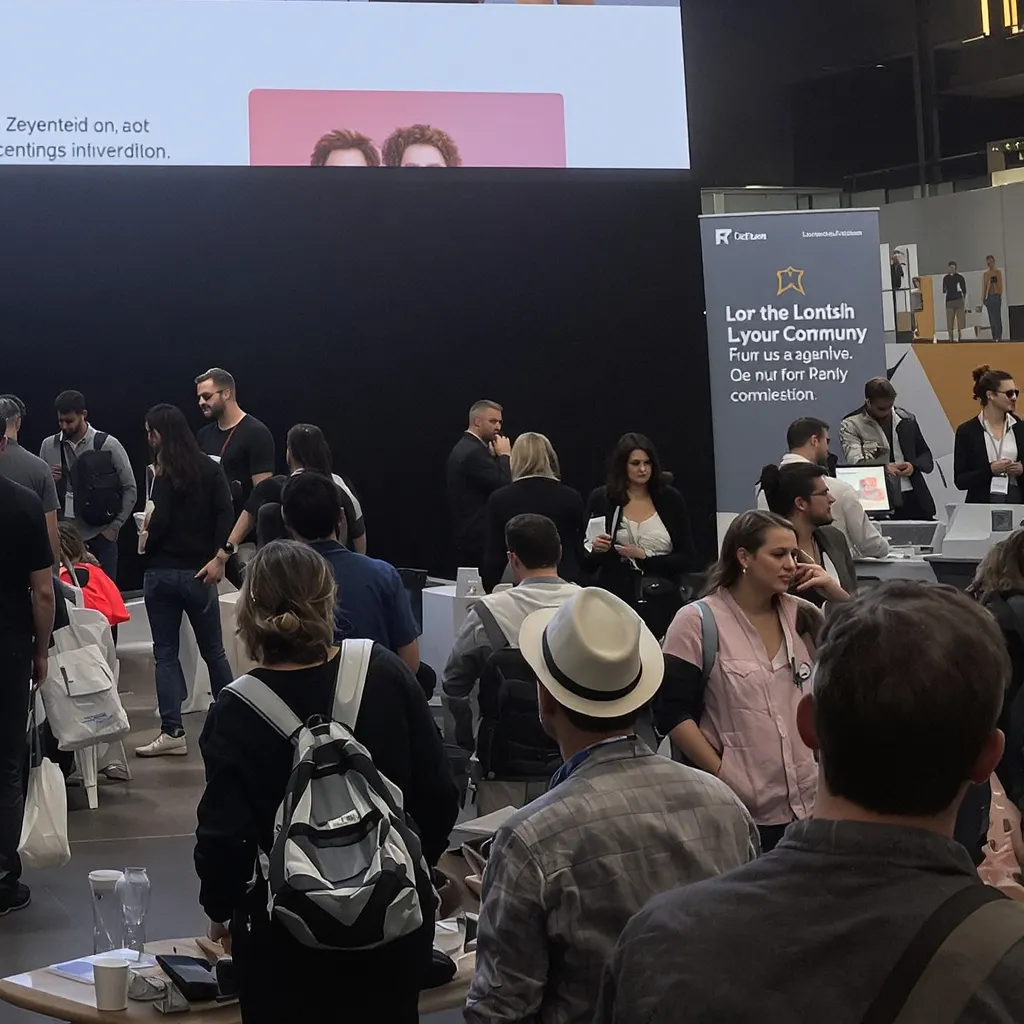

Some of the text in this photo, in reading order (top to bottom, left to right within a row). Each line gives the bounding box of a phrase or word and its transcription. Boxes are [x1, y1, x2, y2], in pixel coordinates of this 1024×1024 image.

[726, 305, 756, 322] Lor
[760, 304, 789, 321] the
[763, 350, 780, 362] us
